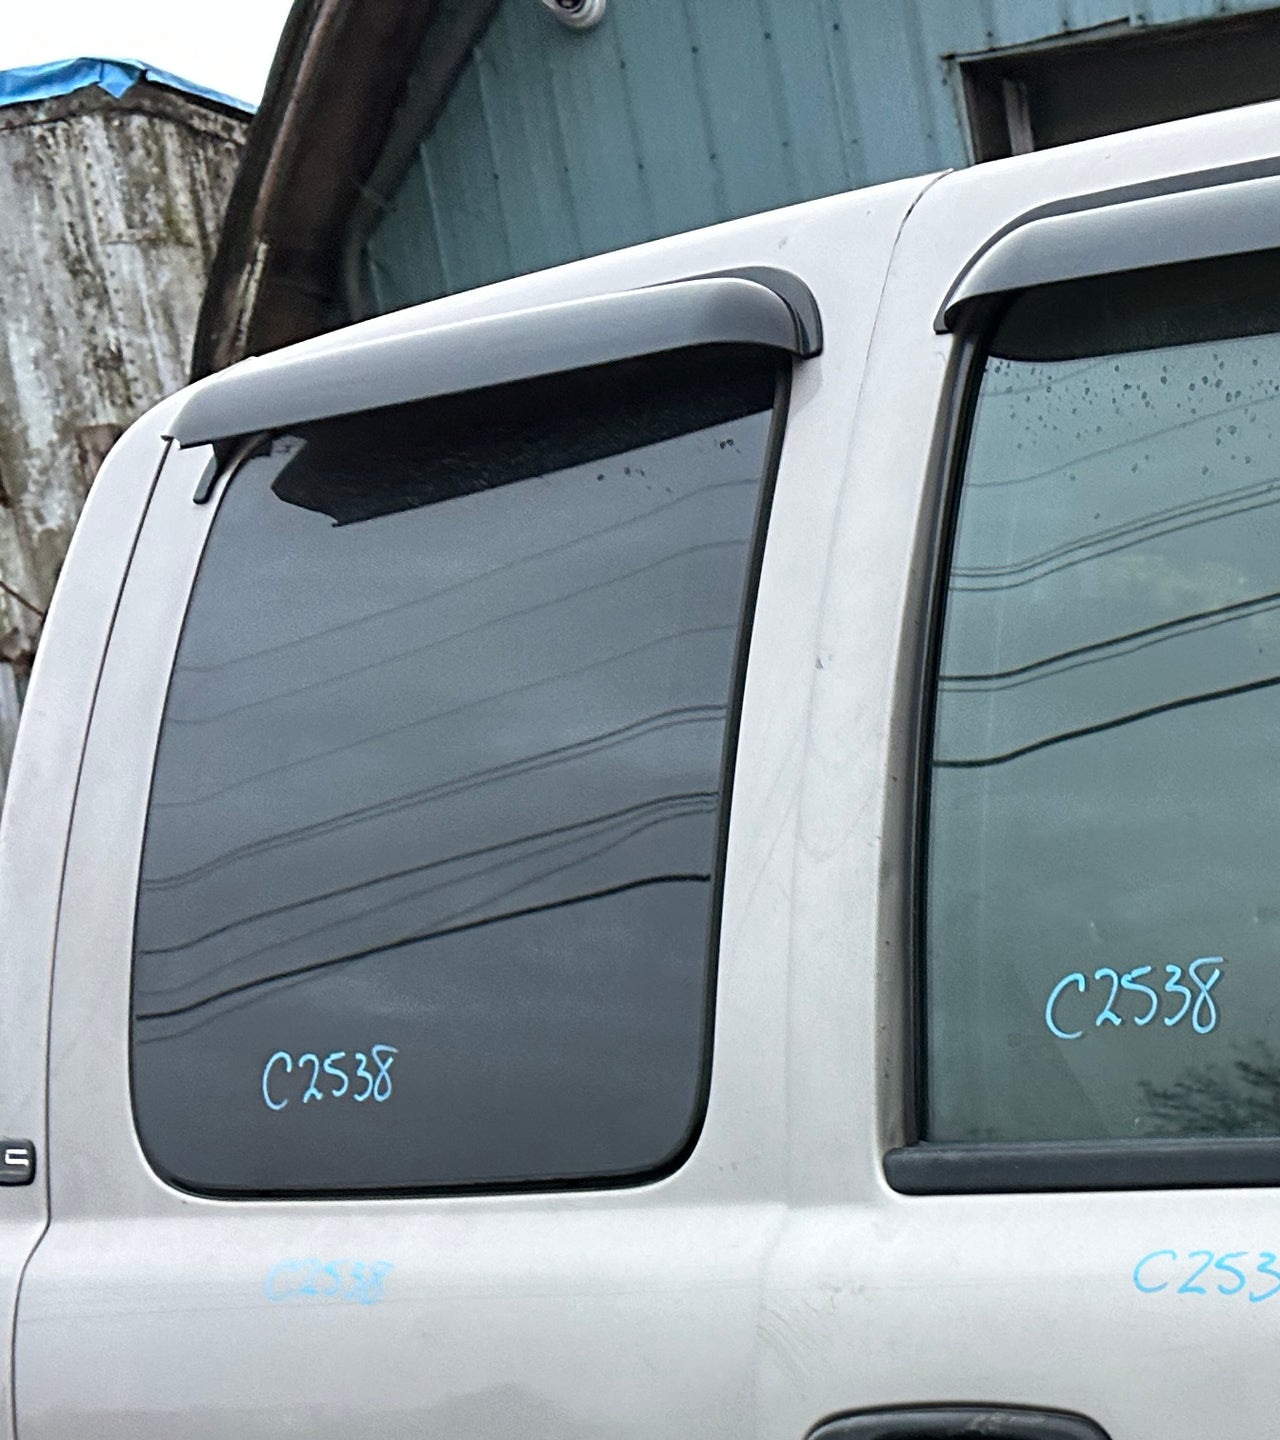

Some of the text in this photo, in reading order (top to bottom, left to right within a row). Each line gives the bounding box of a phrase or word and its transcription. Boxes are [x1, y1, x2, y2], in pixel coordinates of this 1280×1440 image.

[1044, 955, 1225, 1040] C2538
[262, 1043, 399, 1111] C2538
[265, 1258, 395, 1305] C2538
